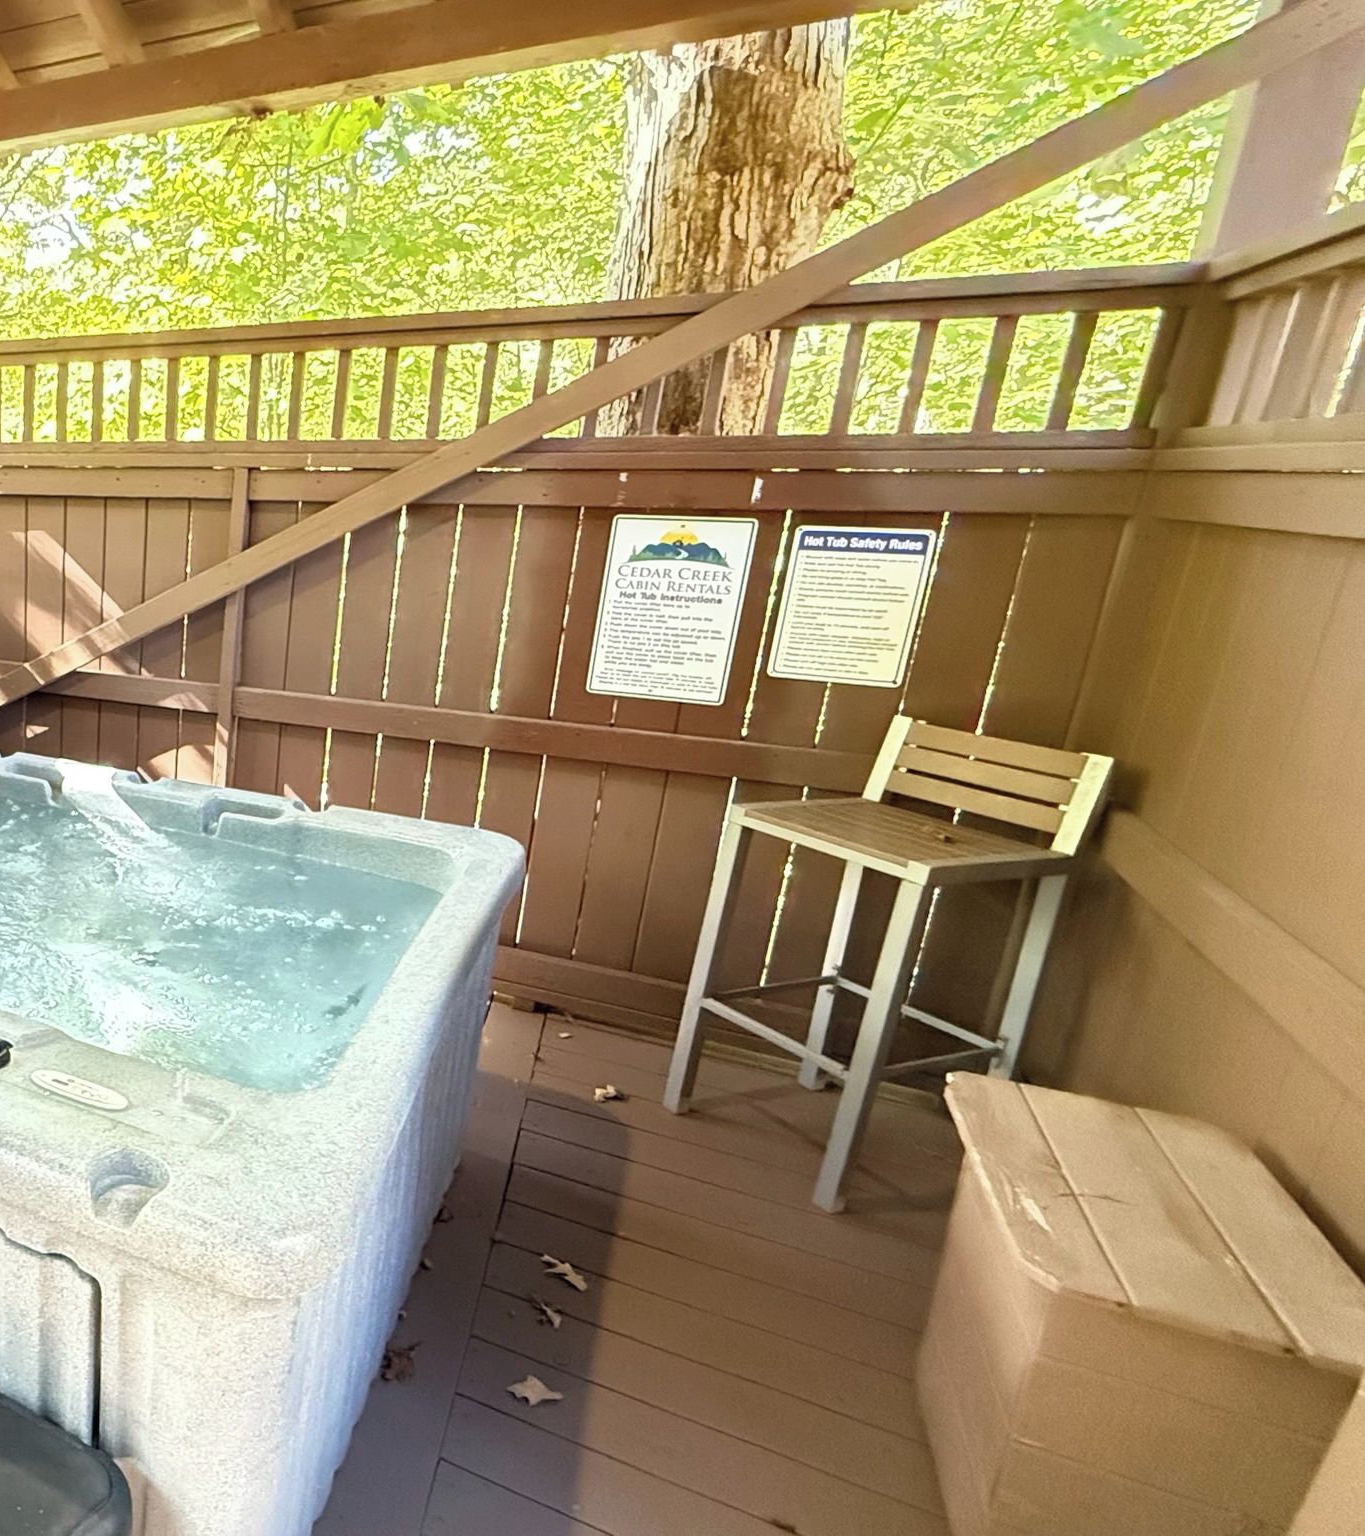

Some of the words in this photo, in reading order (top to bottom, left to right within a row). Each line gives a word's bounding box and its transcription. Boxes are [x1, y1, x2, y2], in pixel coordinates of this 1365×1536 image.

[804, 535, 824, 546] Hot
[826, 537, 848, 548] Tub
[849, 538, 887, 551] Safety
[889, 539, 923, 551] Rules
[617, 564, 672, 579] CEDAR
[678, 567, 733, 583] CREEK
[615, 578, 661, 591] CABIN
[666, 581, 732, 595] RENTALS
[619, 591, 637, 599] Hot
[640, 592, 657, 600] Tub
[660, 593, 723, 604] Instructions
